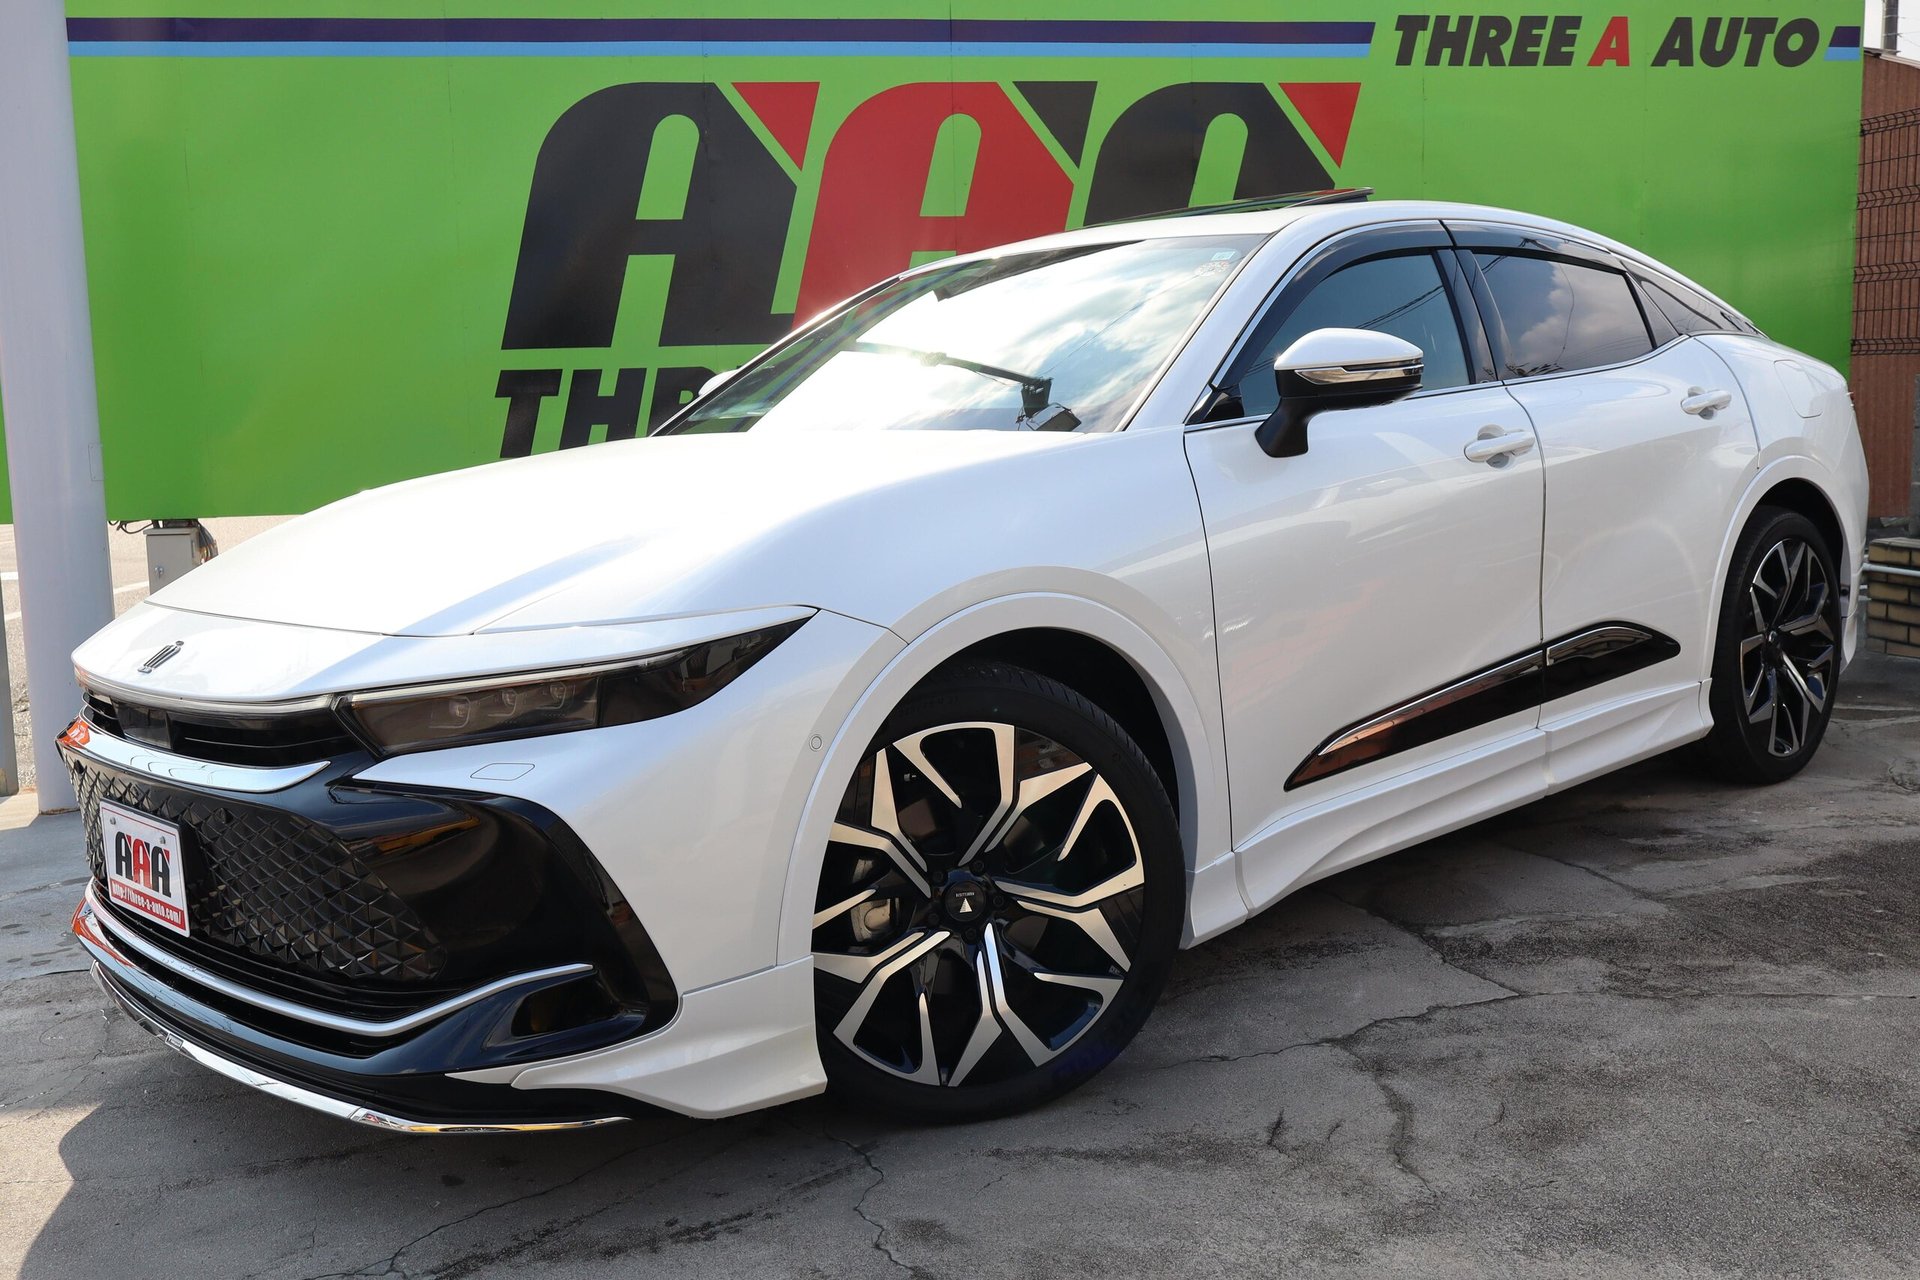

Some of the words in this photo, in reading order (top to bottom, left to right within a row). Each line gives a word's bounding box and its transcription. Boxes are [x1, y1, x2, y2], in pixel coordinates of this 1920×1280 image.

[1394, 14, 1582, 68] THREE
[1587, 16, 1631, 67] A
[1651, 17, 1820, 68] AUTO
